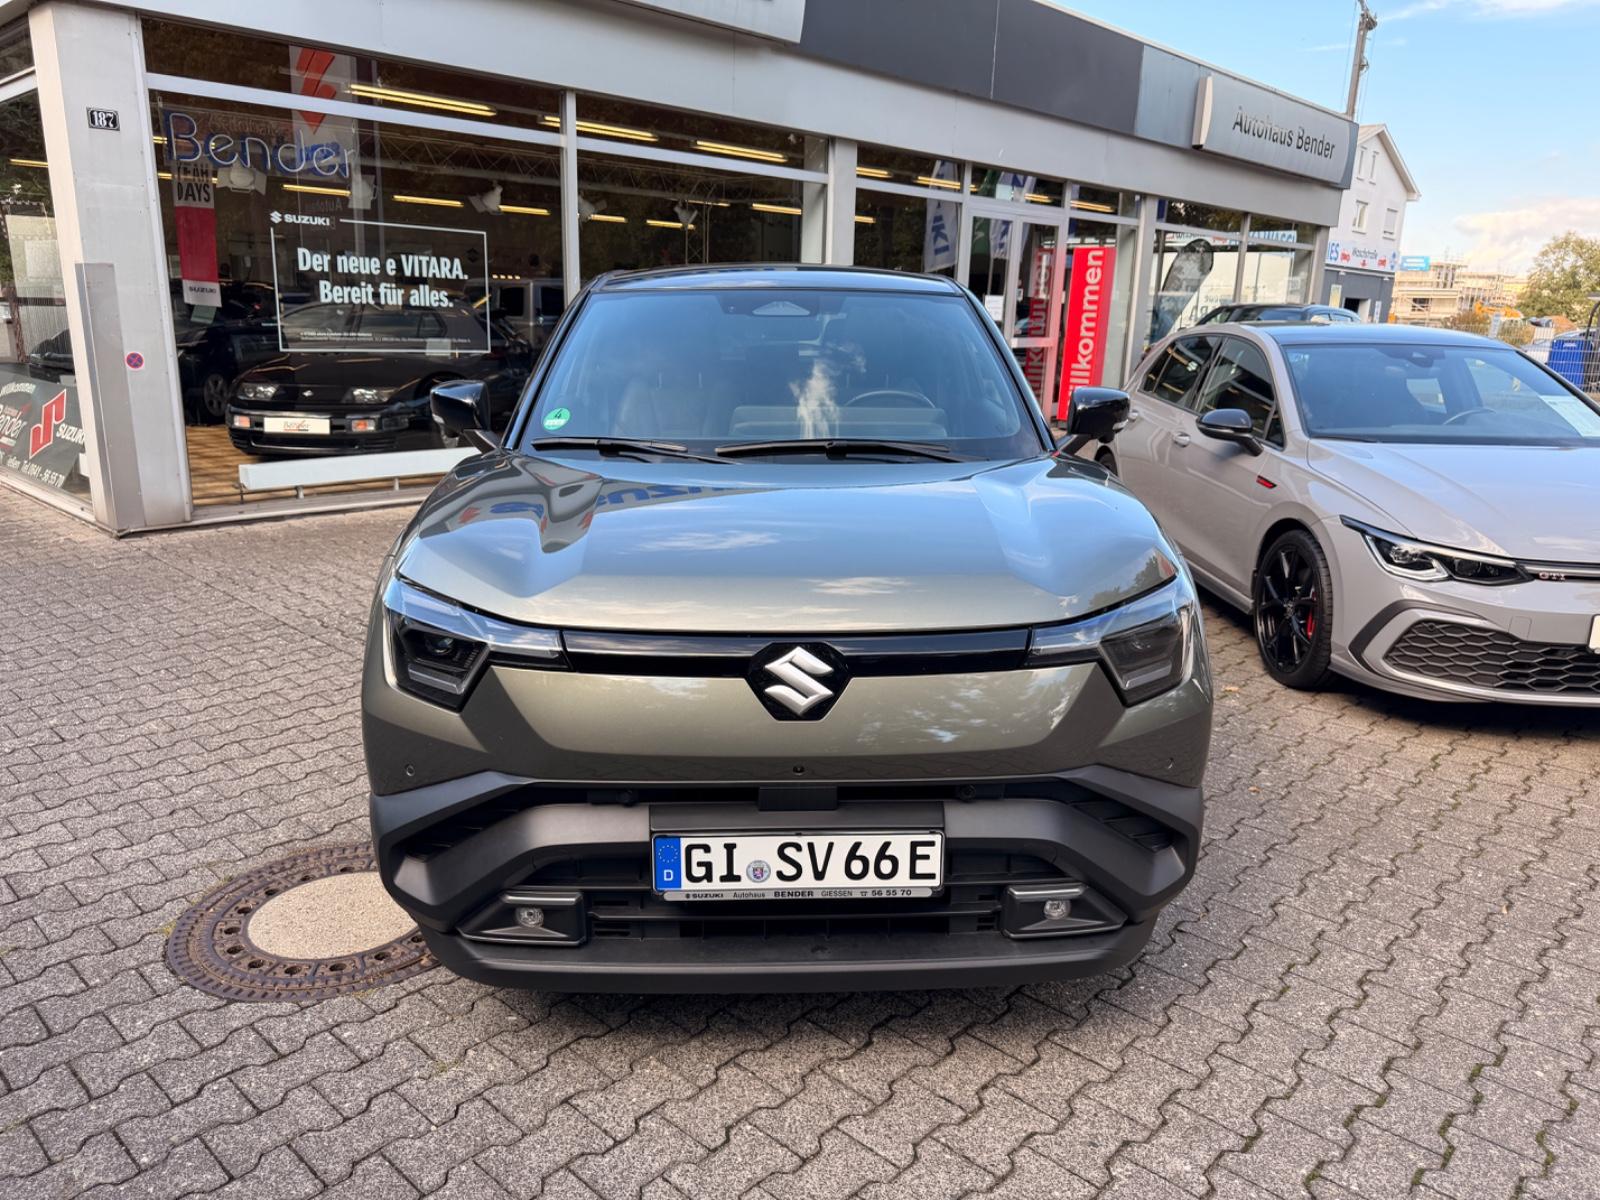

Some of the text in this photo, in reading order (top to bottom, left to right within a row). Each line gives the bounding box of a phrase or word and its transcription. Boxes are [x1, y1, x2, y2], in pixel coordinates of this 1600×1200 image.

[93, 111, 114, 128] 187
[163, 107, 355, 179] Bender
[1231, 105, 1336, 160] Autohaus Bender
[177, 182, 211, 203] DAYS
[284, 213, 330, 226] SUZUKI
[297, 247, 469, 280] Der neue e VITARA.
[319, 279, 454, 308] Bereit für alles.
[1067, 250, 1104, 412] llkommen
[1539, 571, 1566, 581] GTI
[684, 839, 937, 884] GI SV 66E
[663, 869, 674, 882] D
[774, 890, 814, 898] BENDER
[871, 889, 883, 897] 56
[885, 889, 897, 897] 55
